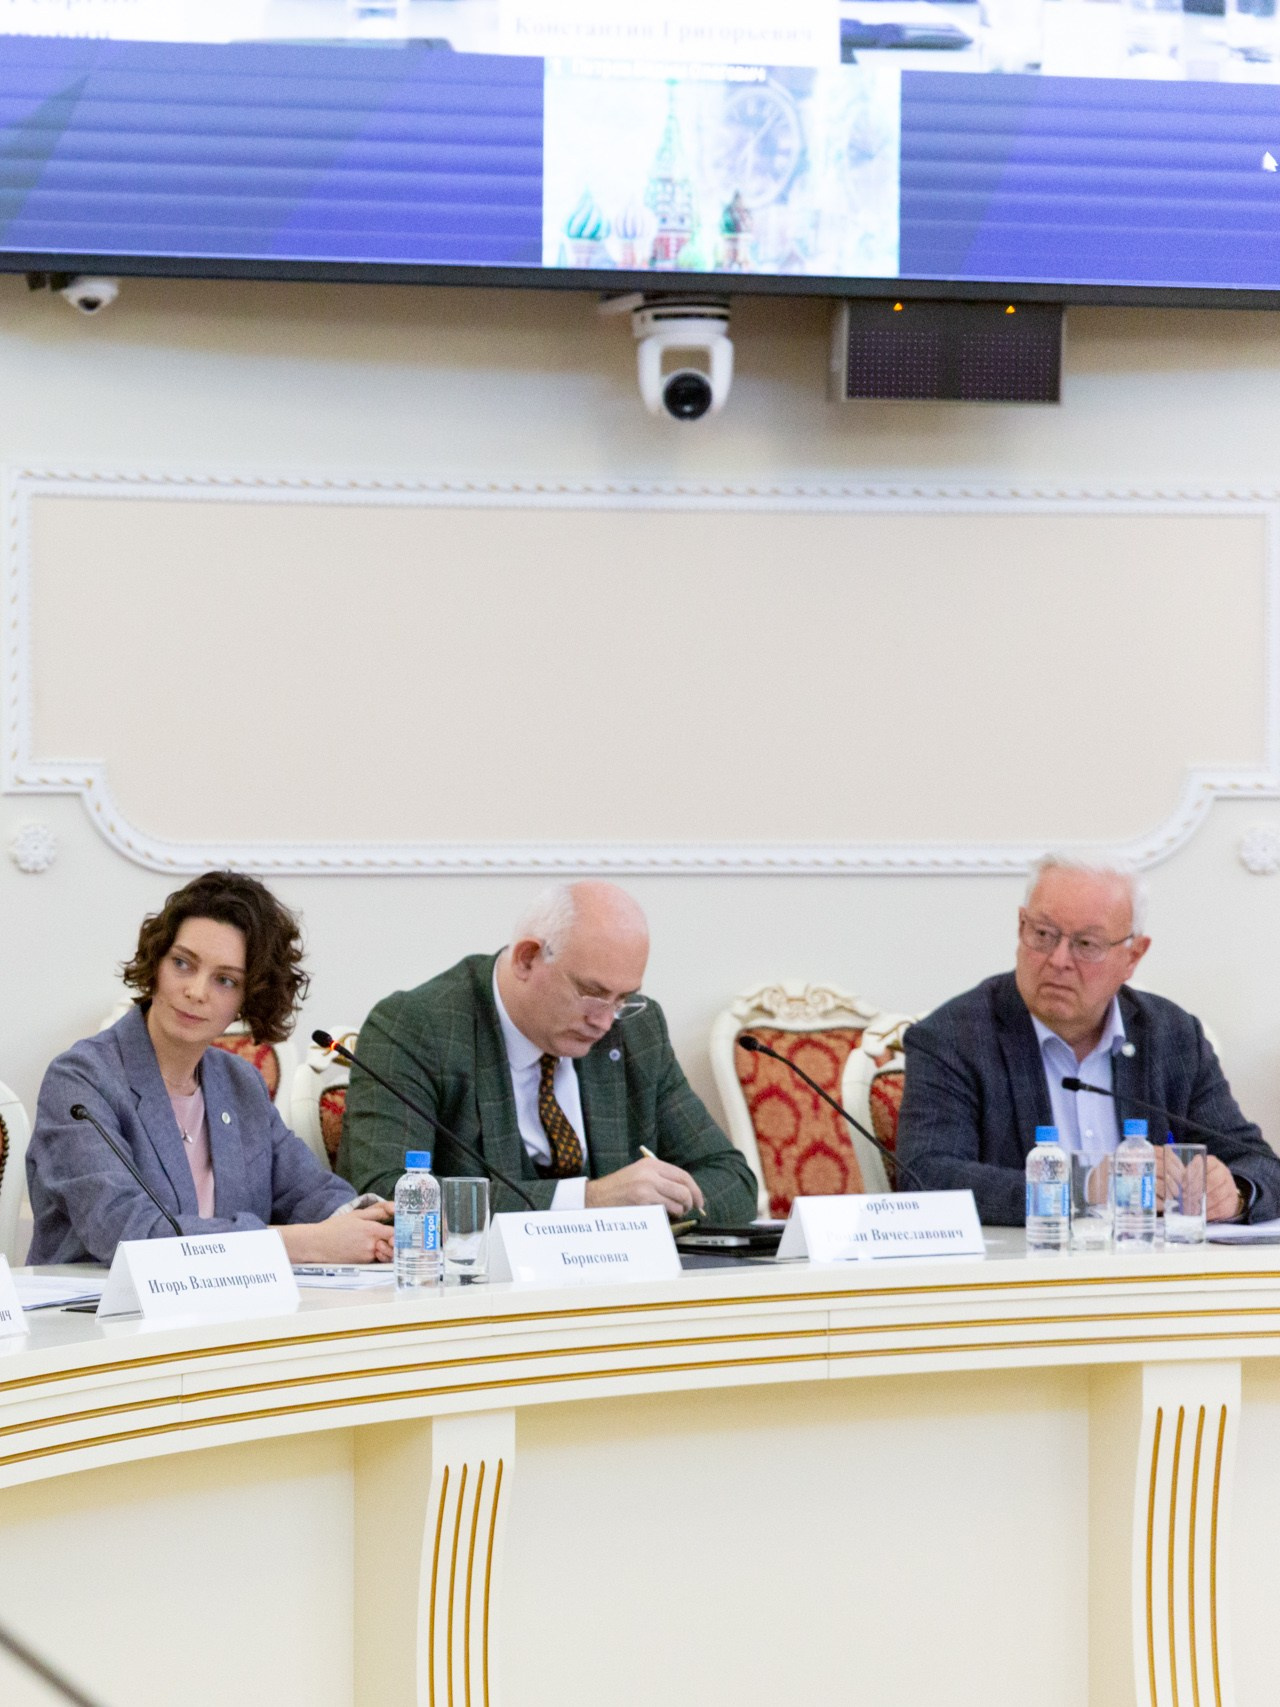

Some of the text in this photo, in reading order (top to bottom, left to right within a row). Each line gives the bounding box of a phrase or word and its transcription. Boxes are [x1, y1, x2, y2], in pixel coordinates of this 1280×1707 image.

[515, 17, 812, 44] Константин Григорьевич
[859, 1199, 920, 1214] орбунов
[425, 1215, 436, 1249] Vorgol
[524, 1219, 648, 1236] Степанова Наталья
[871, 1229, 964, 1242] Вячеславович
[180, 1242, 227, 1256] Ивачев
[561, 1252, 629, 1268] Борисовна
[148, 1272, 278, 1295] Игорь Владимирович
